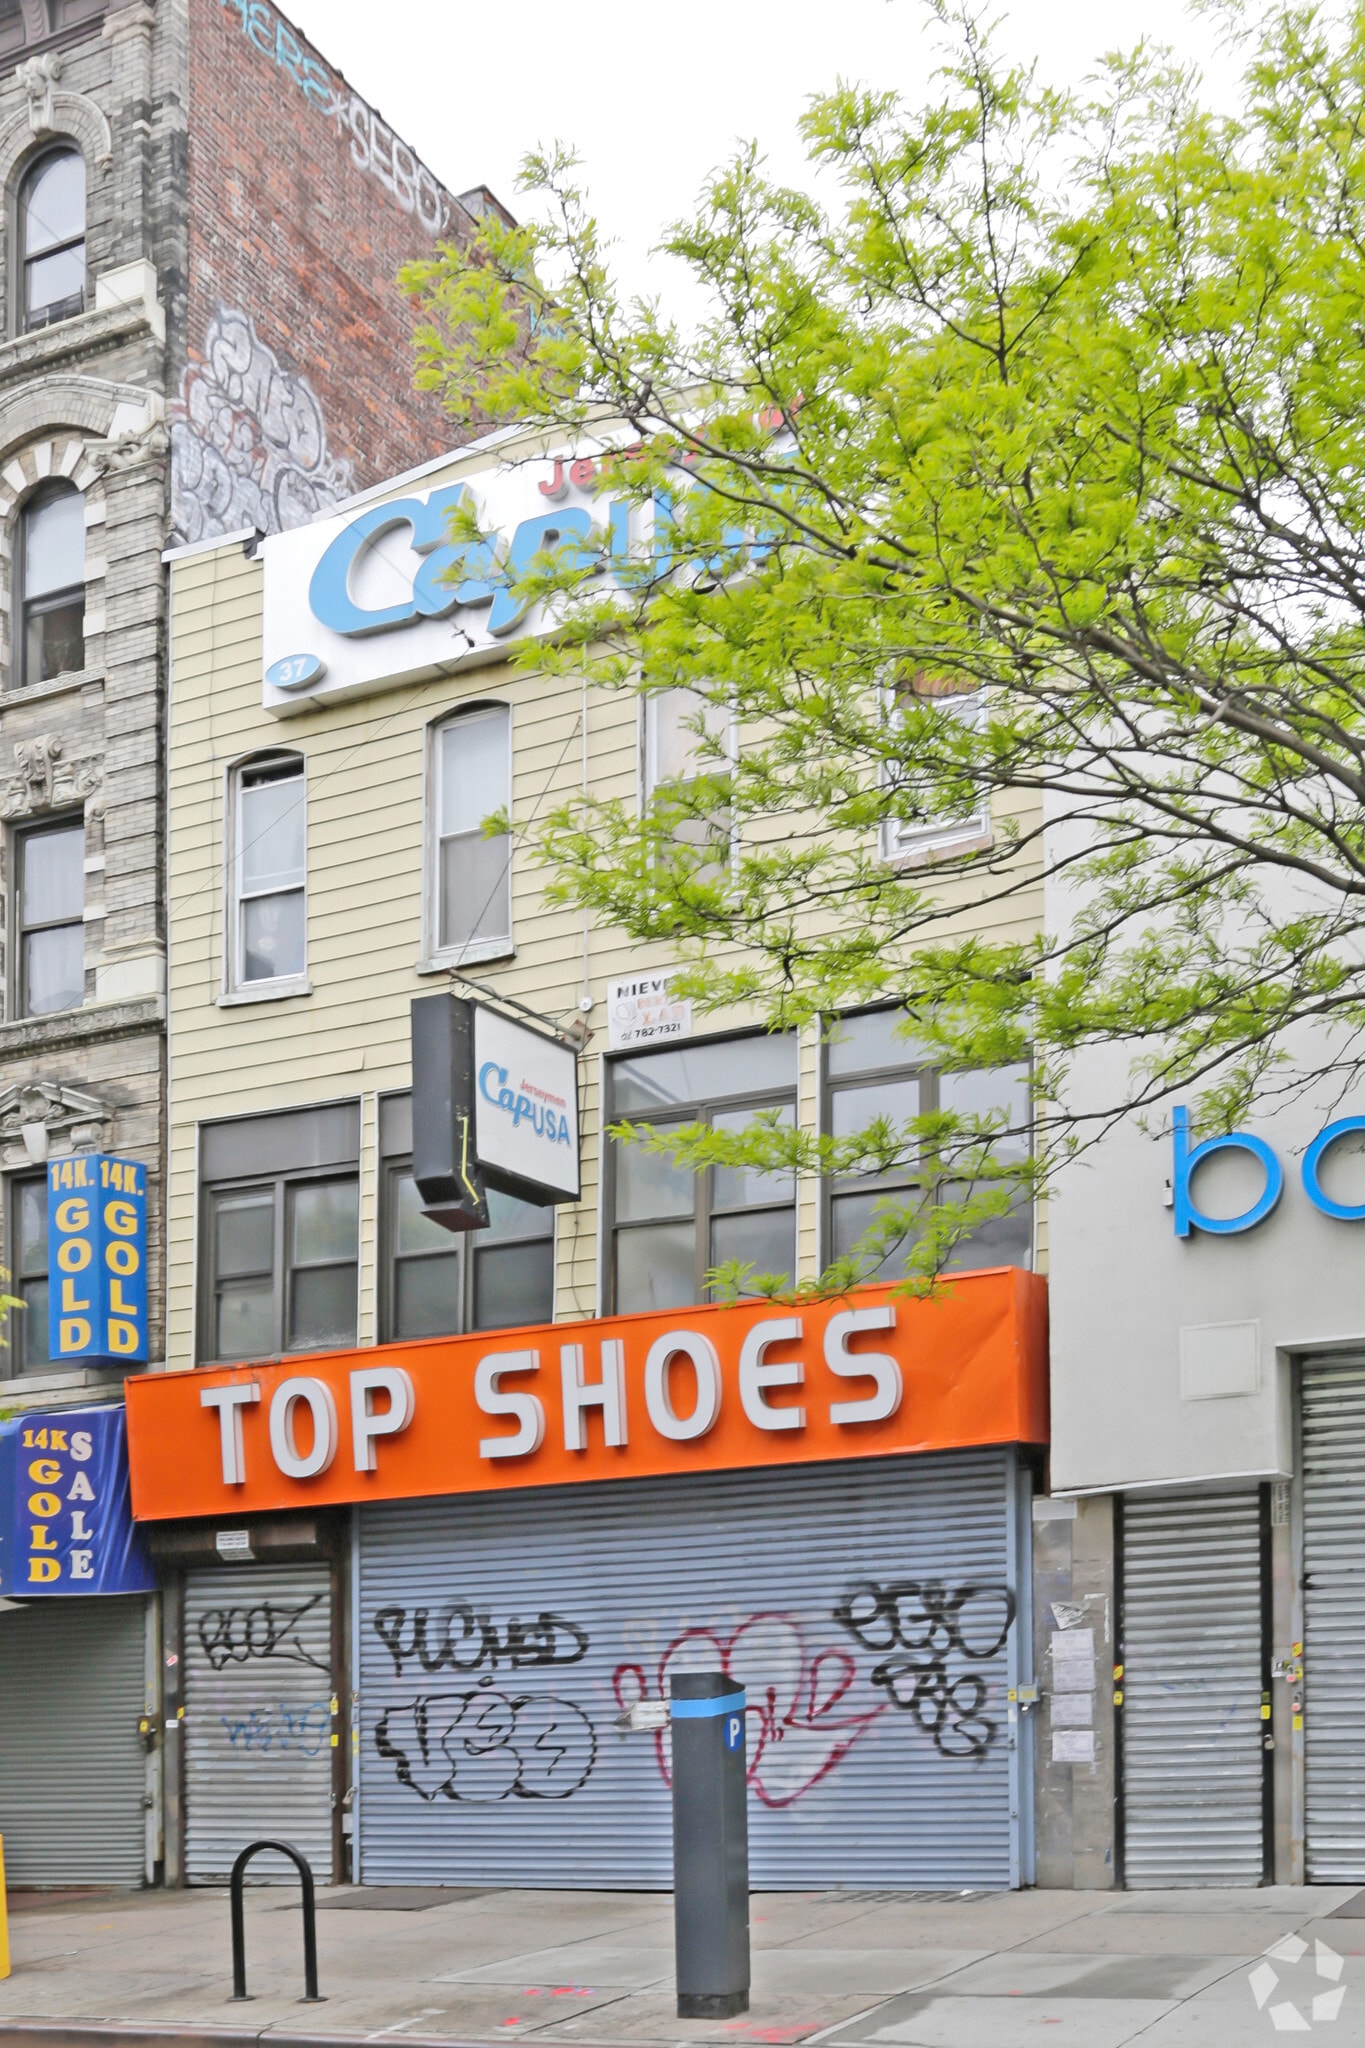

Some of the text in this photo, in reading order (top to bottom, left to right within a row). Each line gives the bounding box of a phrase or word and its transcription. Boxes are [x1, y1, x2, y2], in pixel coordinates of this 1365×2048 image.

[279, 657, 308, 682] 37
[617, 979, 668, 998] NIEV
[51, 1159, 95, 1192] 14K.
[100, 1160, 144, 1196] 14K.
[55, 1197, 92, 1353] GOLD
[103, 1201, 140, 1354] GOLD
[201, 1306, 904, 1484] TOP SHOES
[22, 1428, 69, 1451] 14K
[27, 1458, 64, 1583] GOLD
[66, 1431, 96, 1580] SALE
